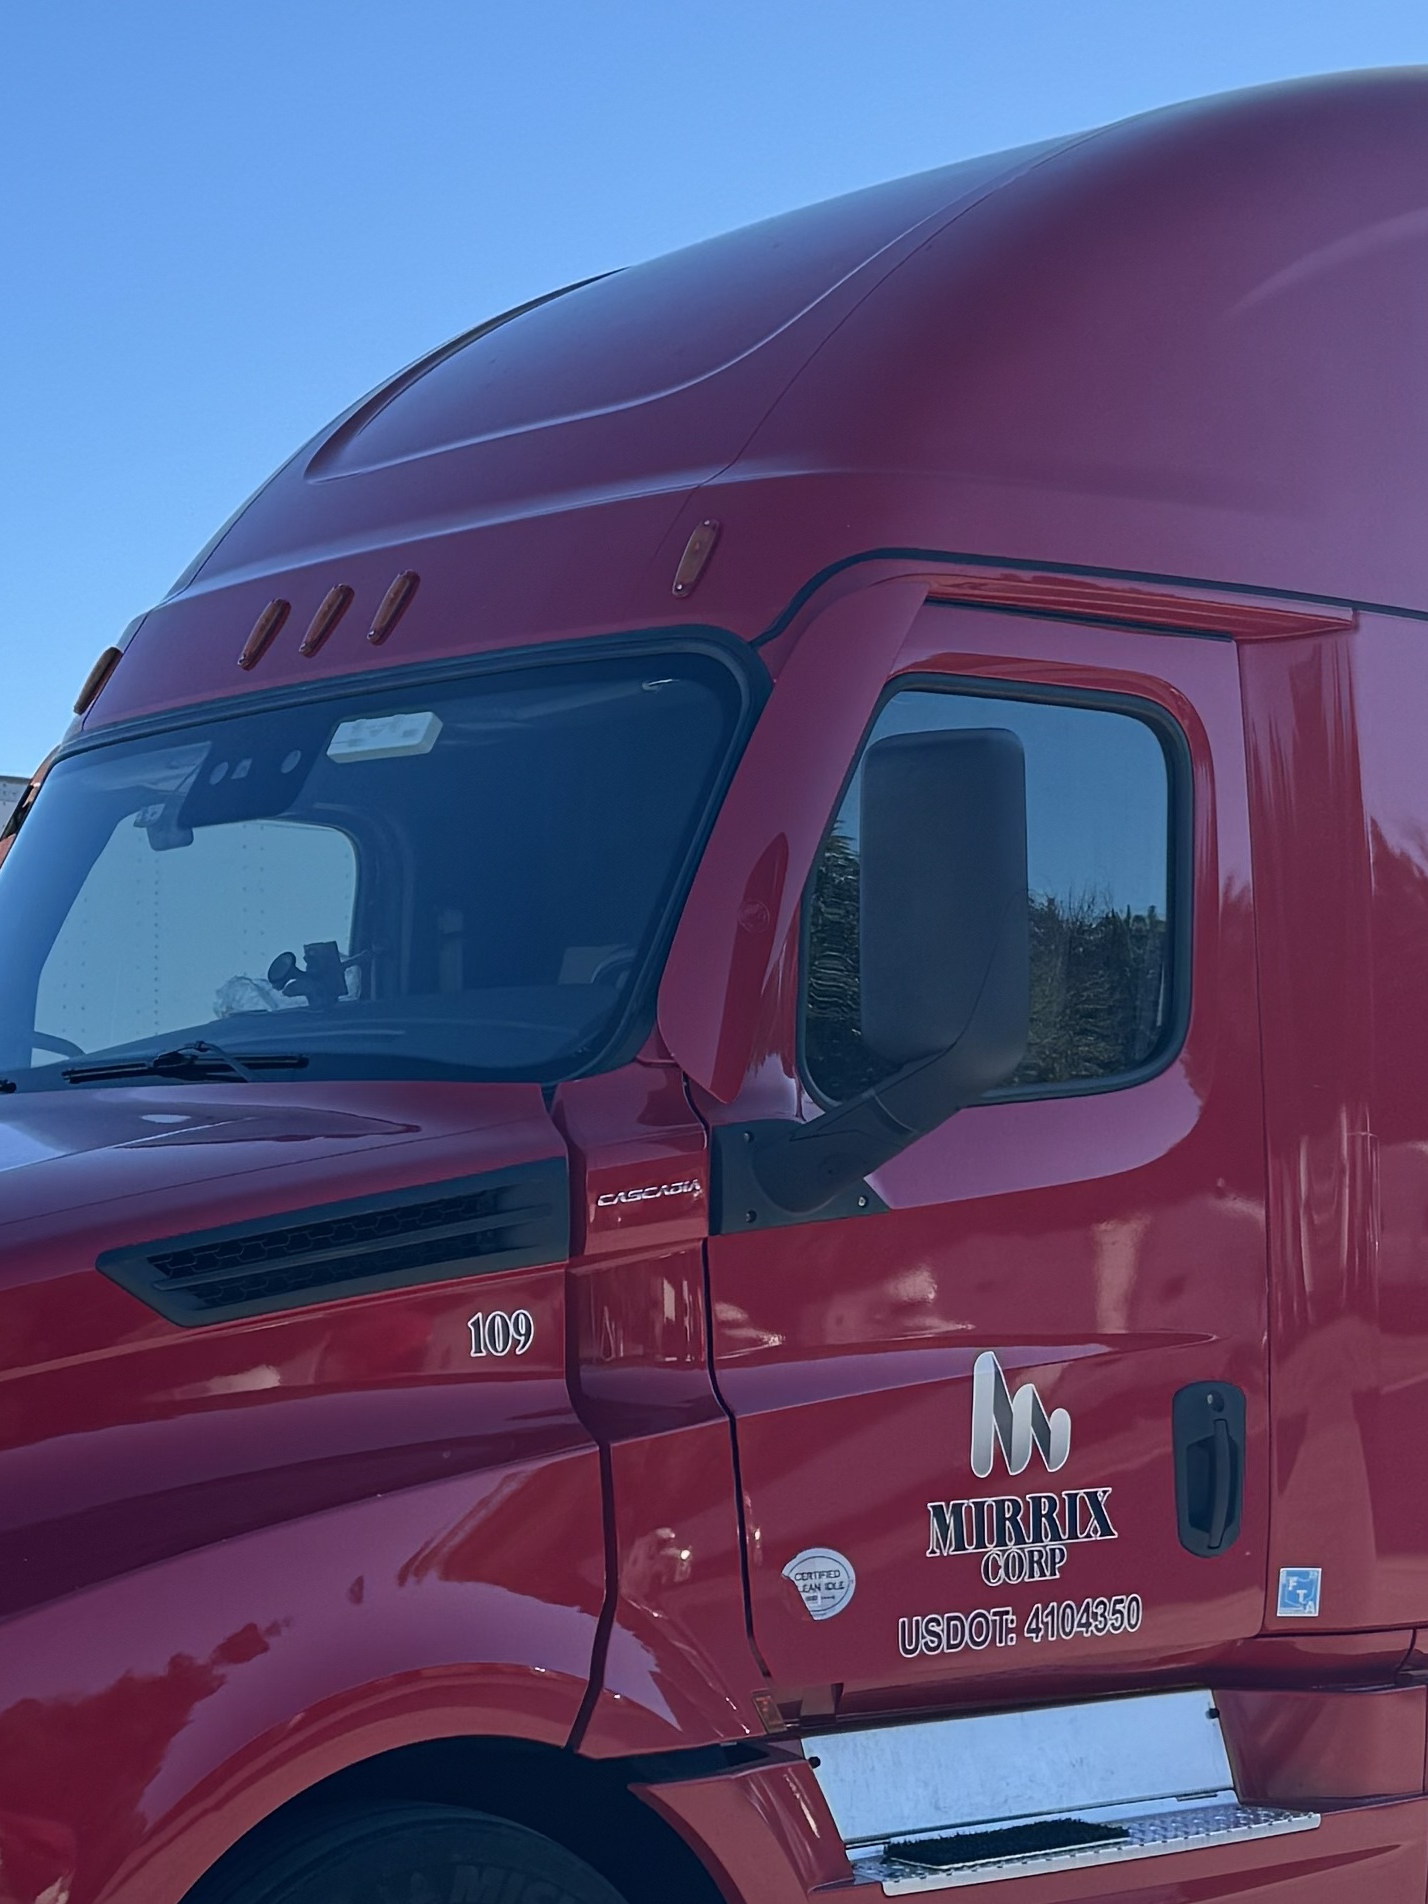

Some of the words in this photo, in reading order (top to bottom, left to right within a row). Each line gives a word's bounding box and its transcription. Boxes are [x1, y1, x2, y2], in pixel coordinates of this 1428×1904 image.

[597, 1178, 703, 1207] CASCADIA
[467, 1309, 535, 1357] 109
[926, 1487, 1119, 1558] MIRRIX
[794, 1569, 841, 1582] CERTIFIED
[825, 1580, 846, 1591] IDLE
[980, 1545, 1068, 1587] CORP
[898, 1606, 1017, 1658] USDOT:
[1024, 1593, 1144, 1643] 4104350
